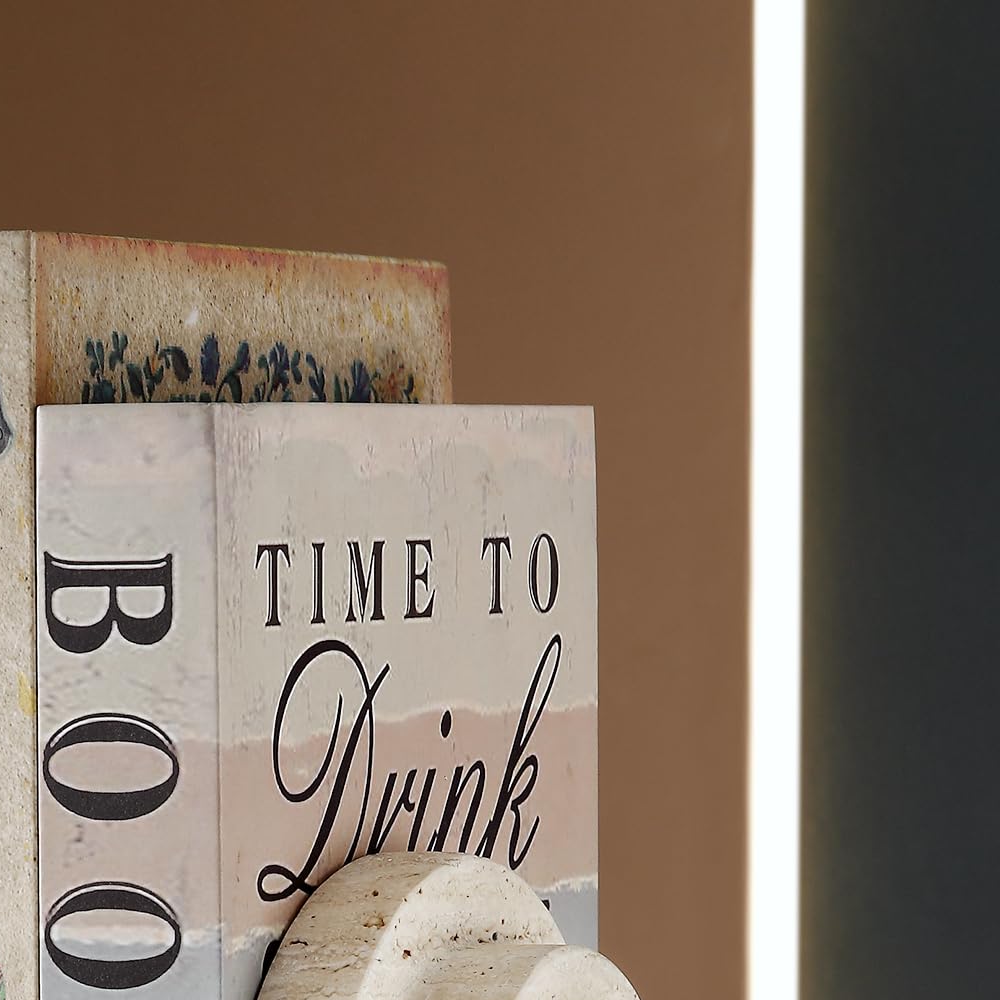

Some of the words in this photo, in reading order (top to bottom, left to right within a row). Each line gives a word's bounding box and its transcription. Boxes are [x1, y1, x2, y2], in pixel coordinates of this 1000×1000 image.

[255, 539, 436, 627] TIME
[481, 533, 562, 614] TO
[258, 634, 562, 902] Drink
